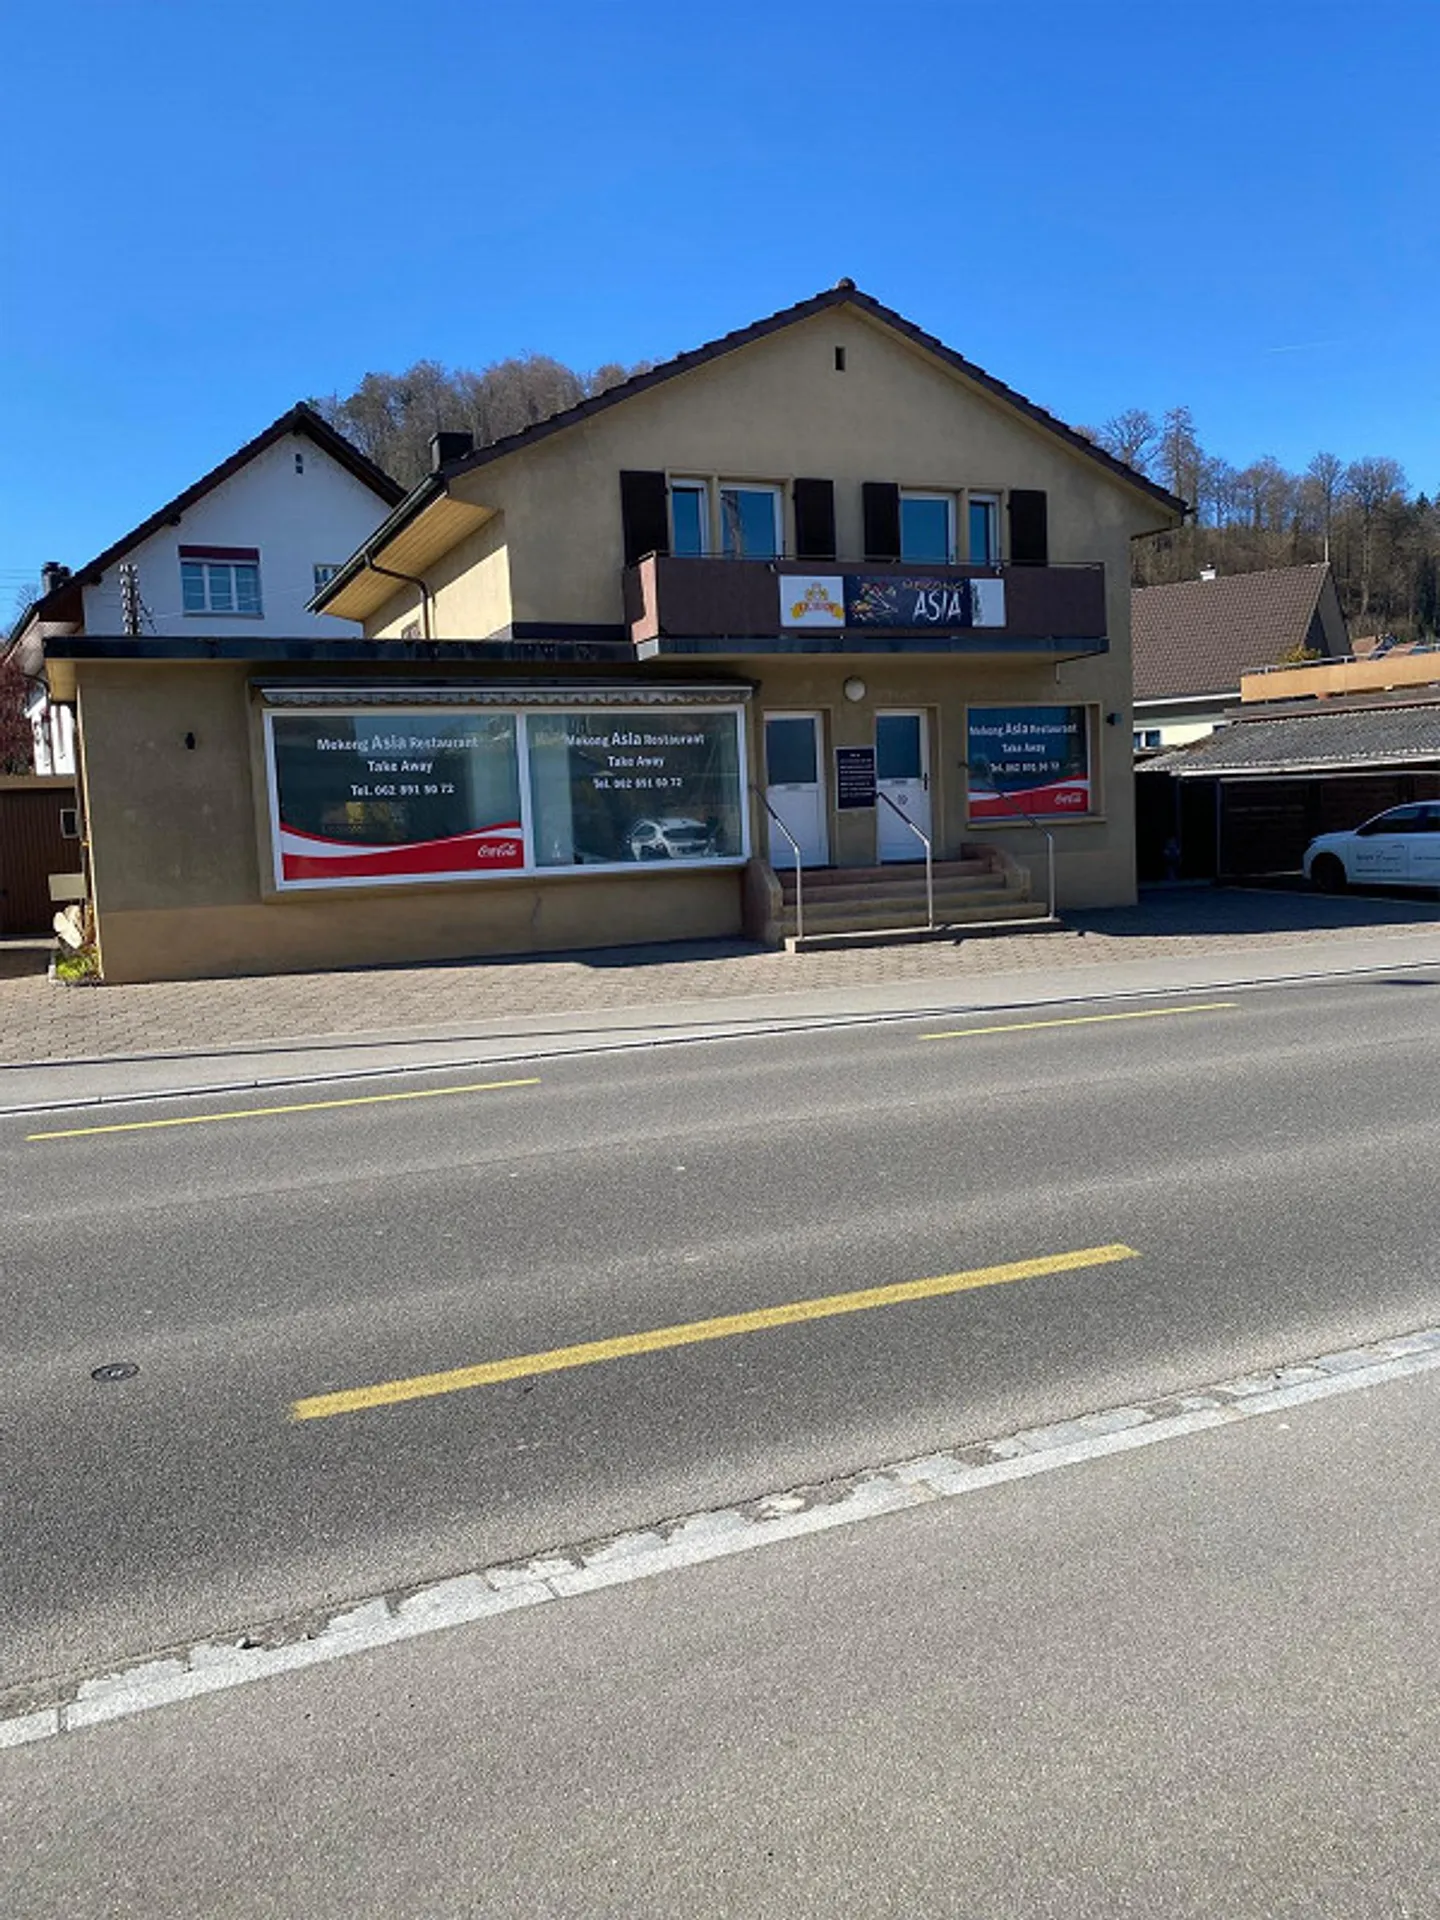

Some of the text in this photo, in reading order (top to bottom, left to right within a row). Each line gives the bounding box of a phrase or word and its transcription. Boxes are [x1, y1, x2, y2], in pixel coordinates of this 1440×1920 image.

[912, 589, 961, 622] ASIA
[316, 734, 478, 752] Mekong Asia Restaurant
[611, 731, 642, 746] Asia
[367, 760, 434, 774] Take Away
[607, 755, 635, 767] Take
